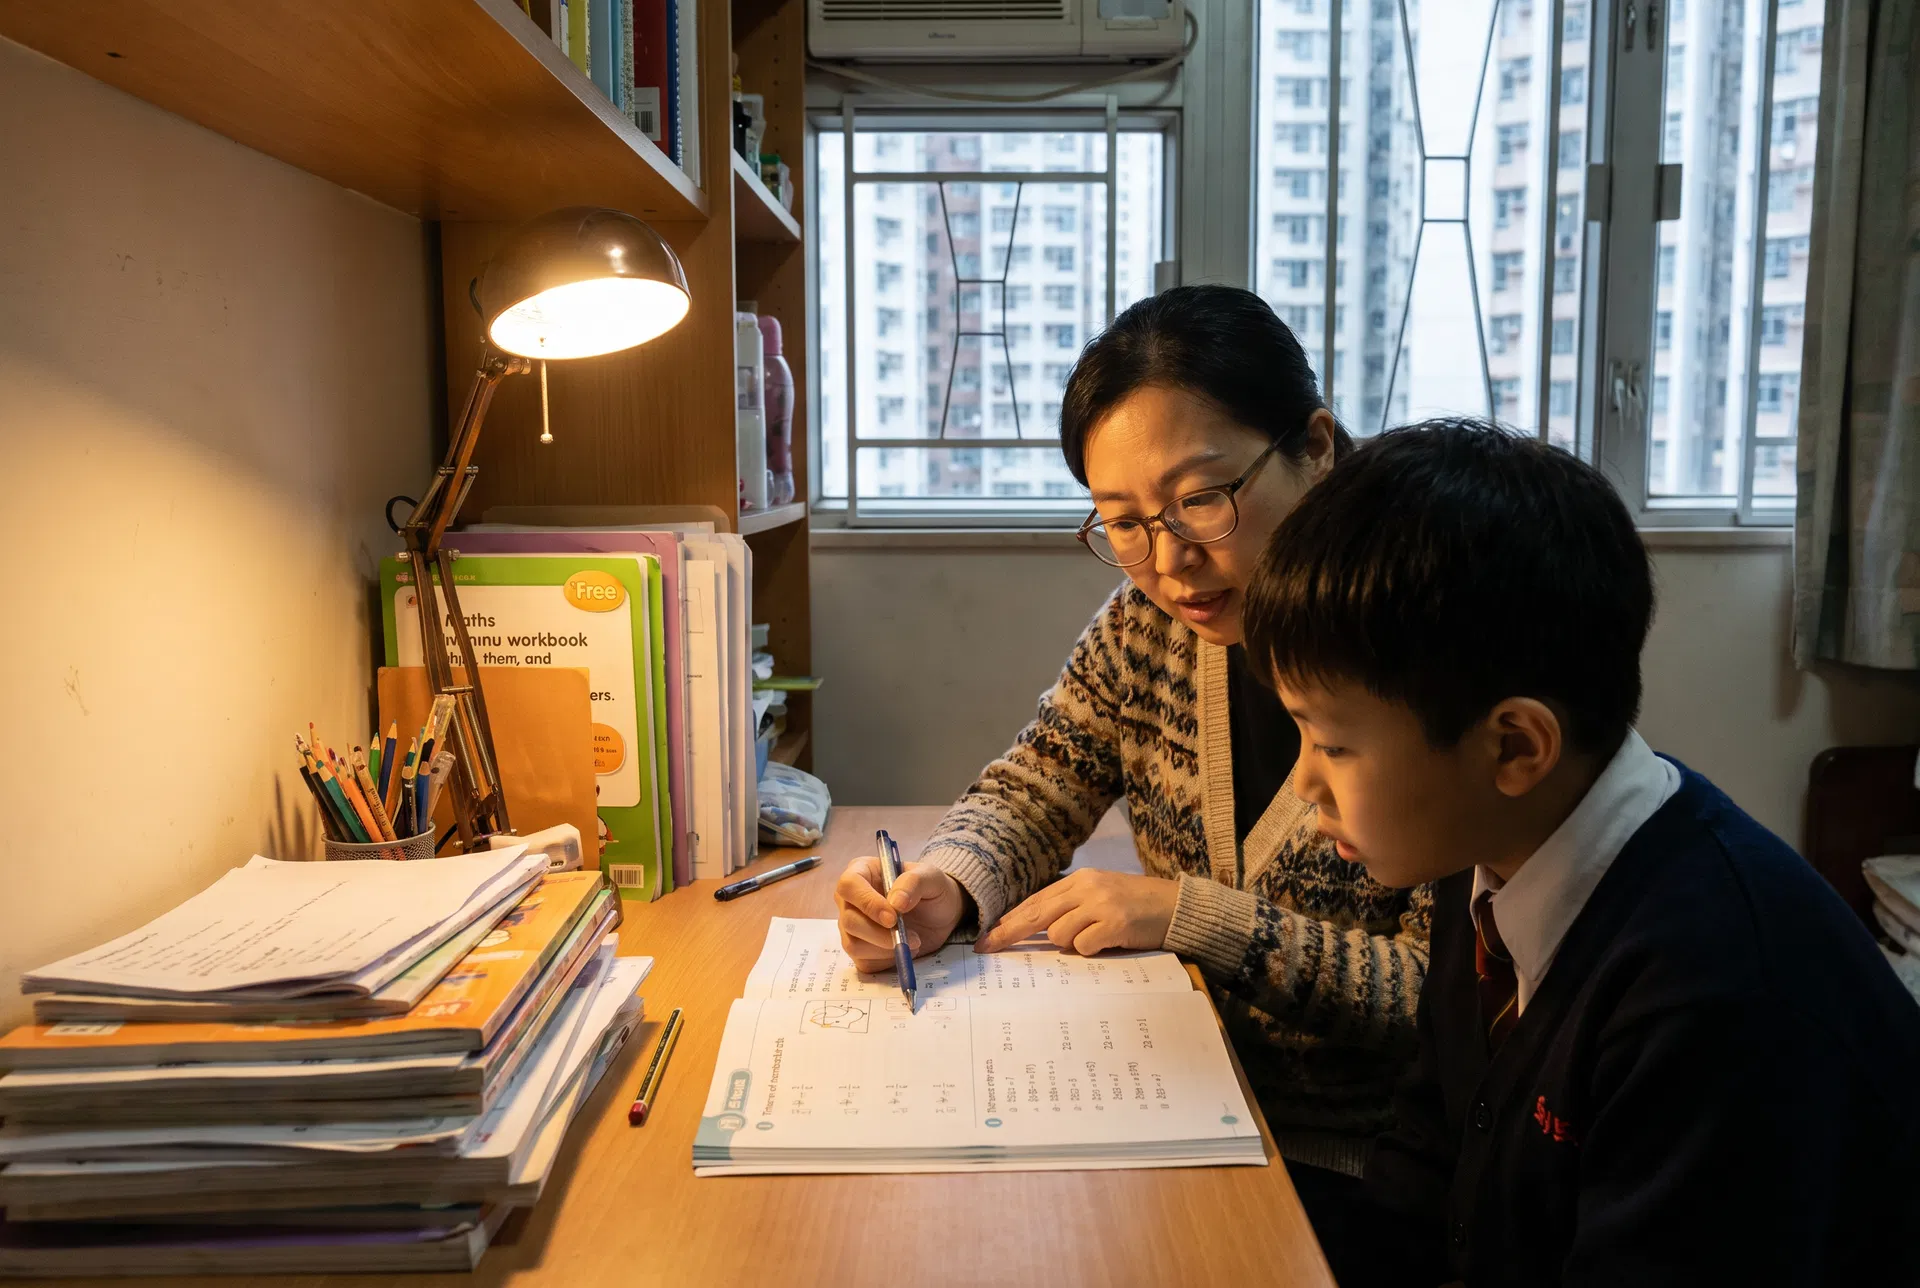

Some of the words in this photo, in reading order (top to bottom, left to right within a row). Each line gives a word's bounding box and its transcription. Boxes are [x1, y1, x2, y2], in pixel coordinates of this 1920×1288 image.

[507, 632, 588, 647] workbook
[483, 652, 520, 666] them,
[525, 652, 551, 665] and
